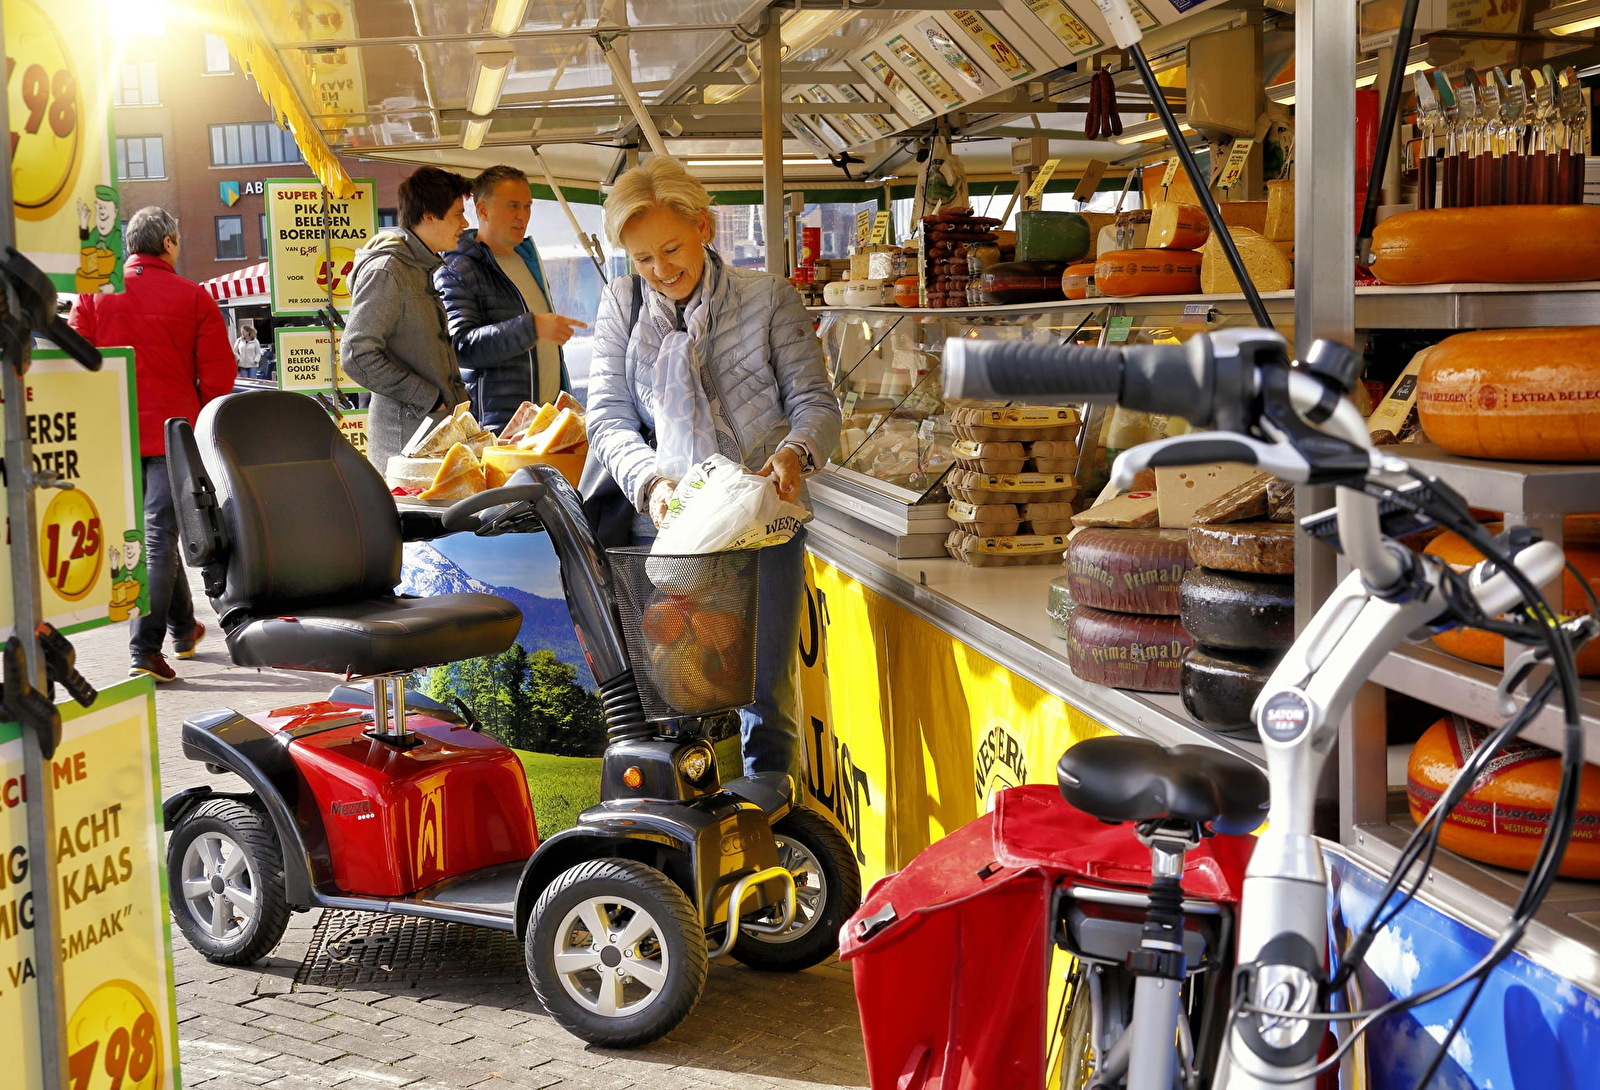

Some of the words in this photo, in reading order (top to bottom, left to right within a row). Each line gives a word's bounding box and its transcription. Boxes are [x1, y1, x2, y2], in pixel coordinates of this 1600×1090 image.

[245, 182, 263, 194] AB
[277, 191, 317, 200] SUPER
[294, 204, 349, 214] PIKANT
[287, 356, 321, 364] BELEGEN
[287, 365, 320, 373] GOUDSE
[1512, 392, 1556, 403] EXTRA
[27, 412, 77, 444] ERSE
[765, 516, 801, 535] WESTE
[46, 517, 100, 589] 1,25
[1123, 568, 1169, 590] Prima
[1172, 564, 1190, 583] Do
[1157, 584, 1181, 593] matu
[1091, 643, 1127, 665] Prima
[1172, 640, 1190, 660] Do
[975, 726, 1028, 801] WESTERH
[804, 714, 871, 867] LIST
[331, 800, 371, 817] Mezzo
[57, 802, 122, 864] ACHT
[62, 846, 133, 911] KAAS
[7, 957, 36, 989] VA
[68, 1011, 154, 1090] 798
